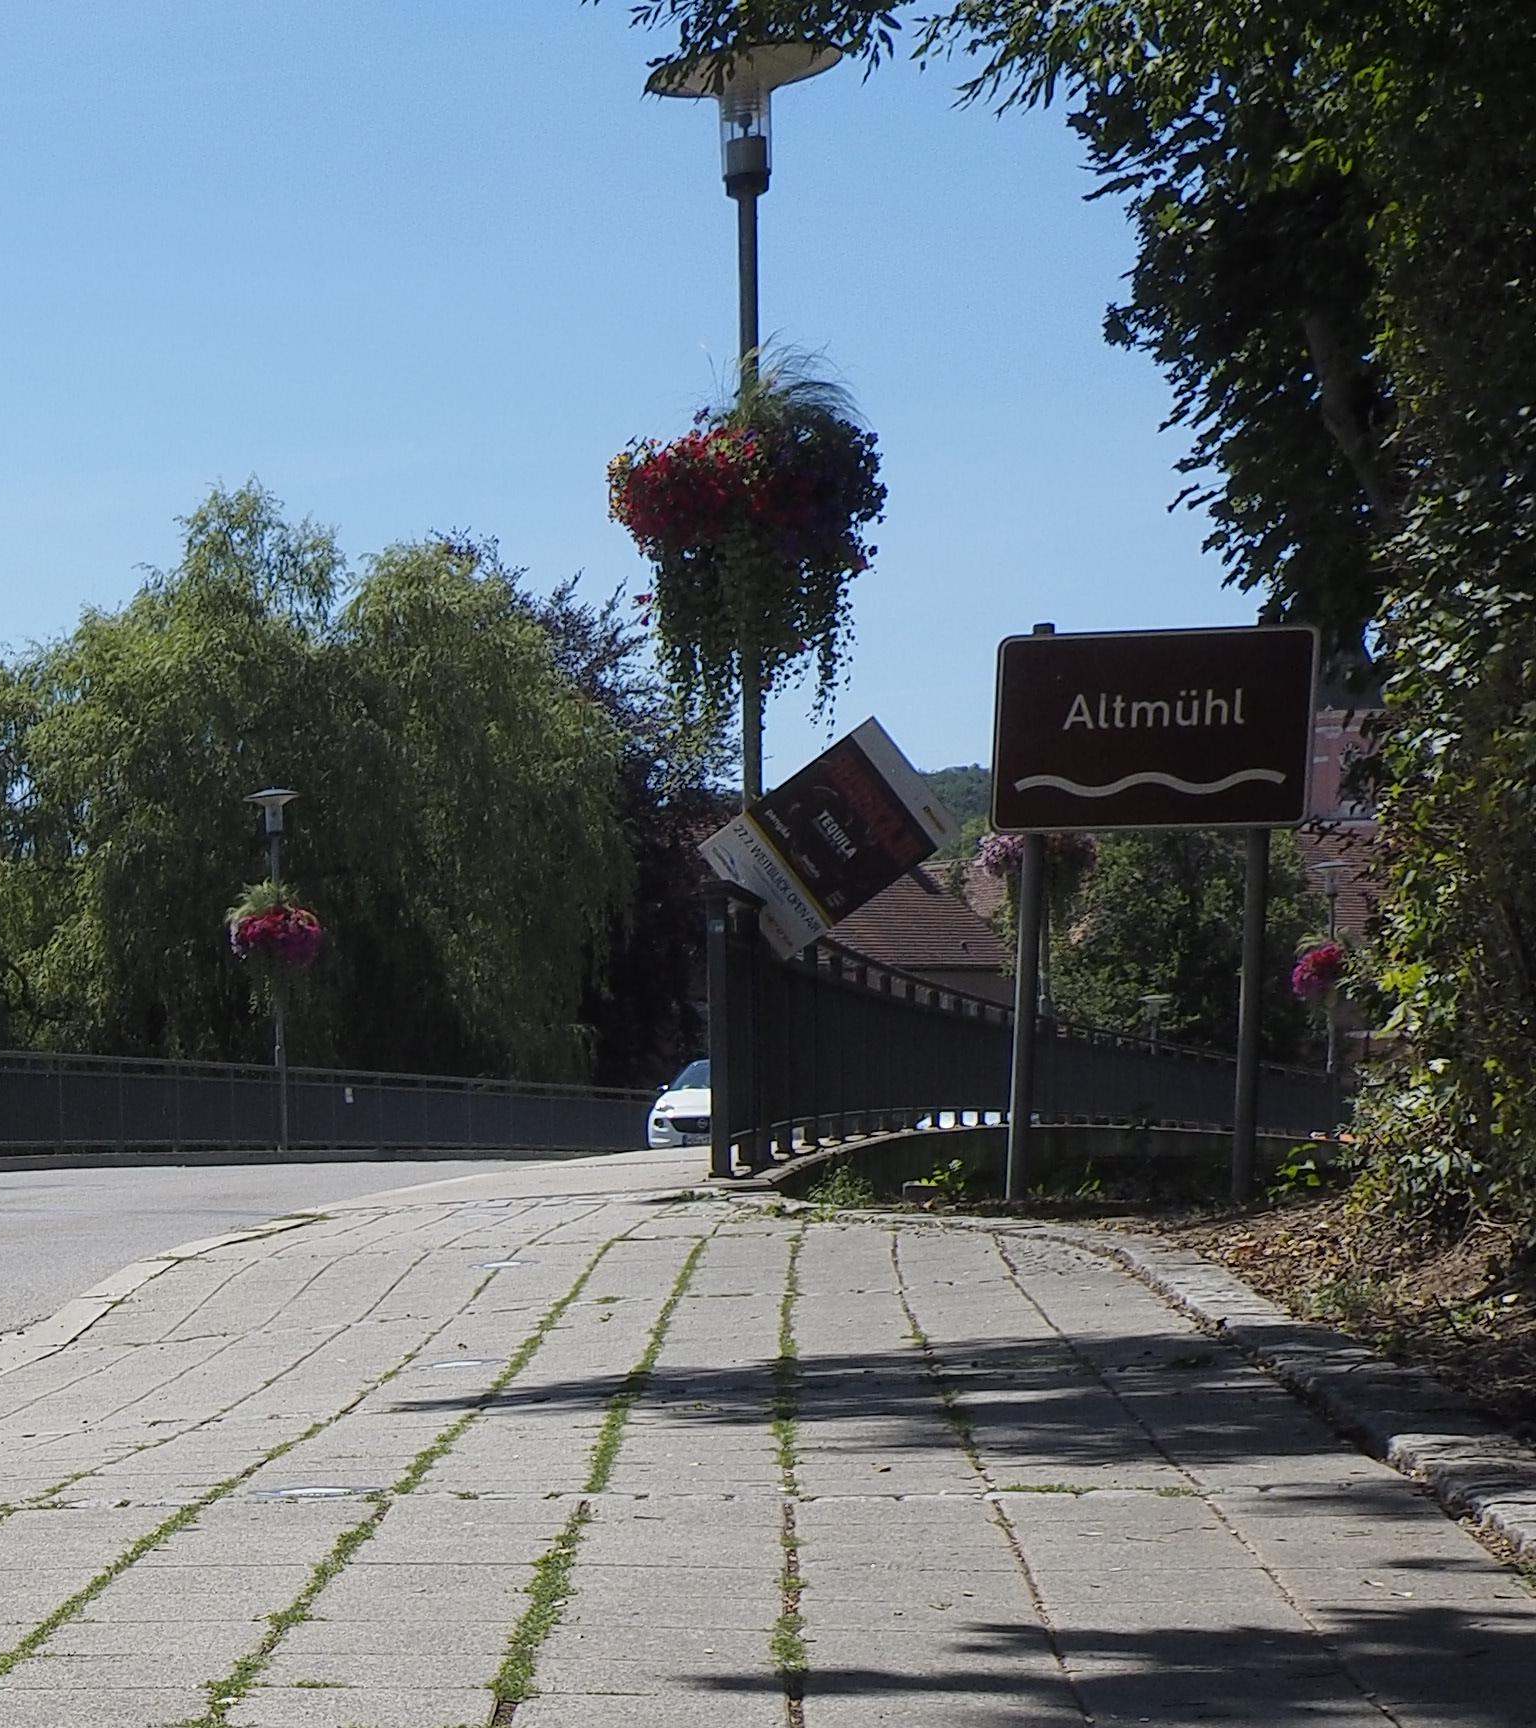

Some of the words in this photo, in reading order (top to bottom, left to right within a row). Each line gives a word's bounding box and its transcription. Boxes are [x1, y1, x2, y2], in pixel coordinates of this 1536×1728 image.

[1062, 688, 1245, 730] Altmühl
[814, 809, 860, 860] TEQUILA
[748, 845, 792, 895] WEITBLICK
[785, 892, 810, 920] OPEN
[802, 914, 820, 934] AIR
